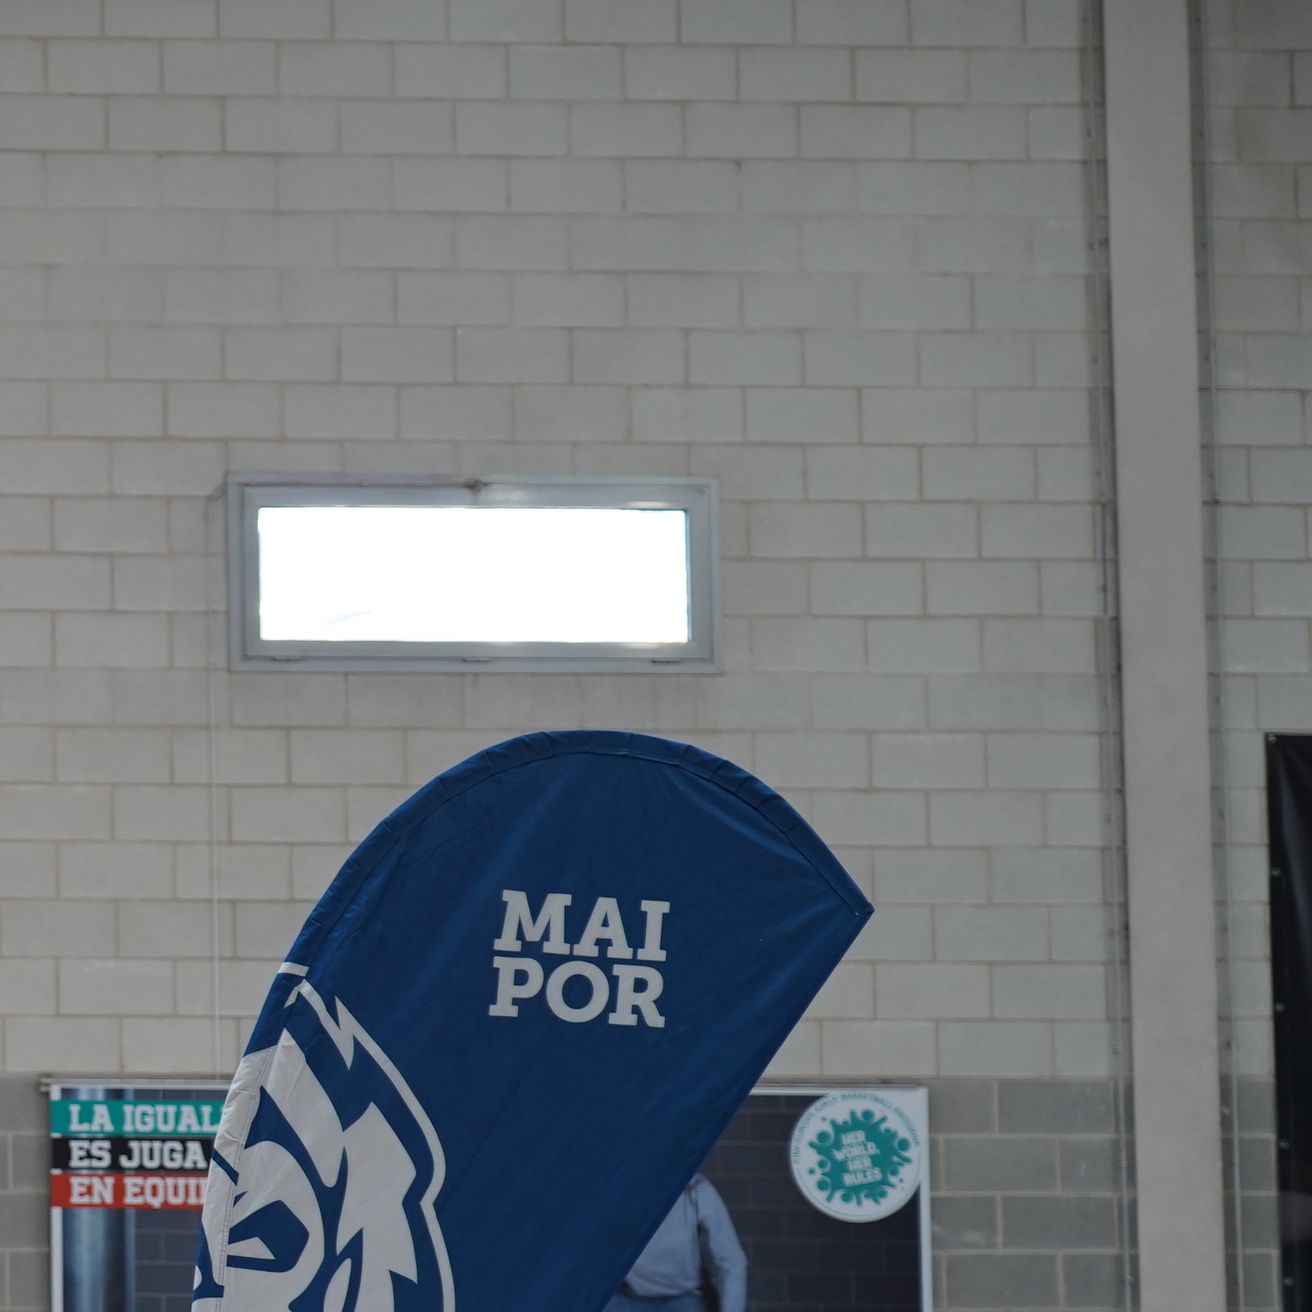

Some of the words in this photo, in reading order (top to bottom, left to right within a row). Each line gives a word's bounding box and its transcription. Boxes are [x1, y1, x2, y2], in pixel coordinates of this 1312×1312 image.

[493, 889, 671, 962] MAI
[488, 955, 666, 1028] POR
[68, 1103, 115, 1132] LA
[122, 1103, 224, 1133] IGUAL
[69, 1139, 112, 1168] ES
[118, 1139, 208, 1169] JUGA
[69, 1175, 116, 1204] EN
